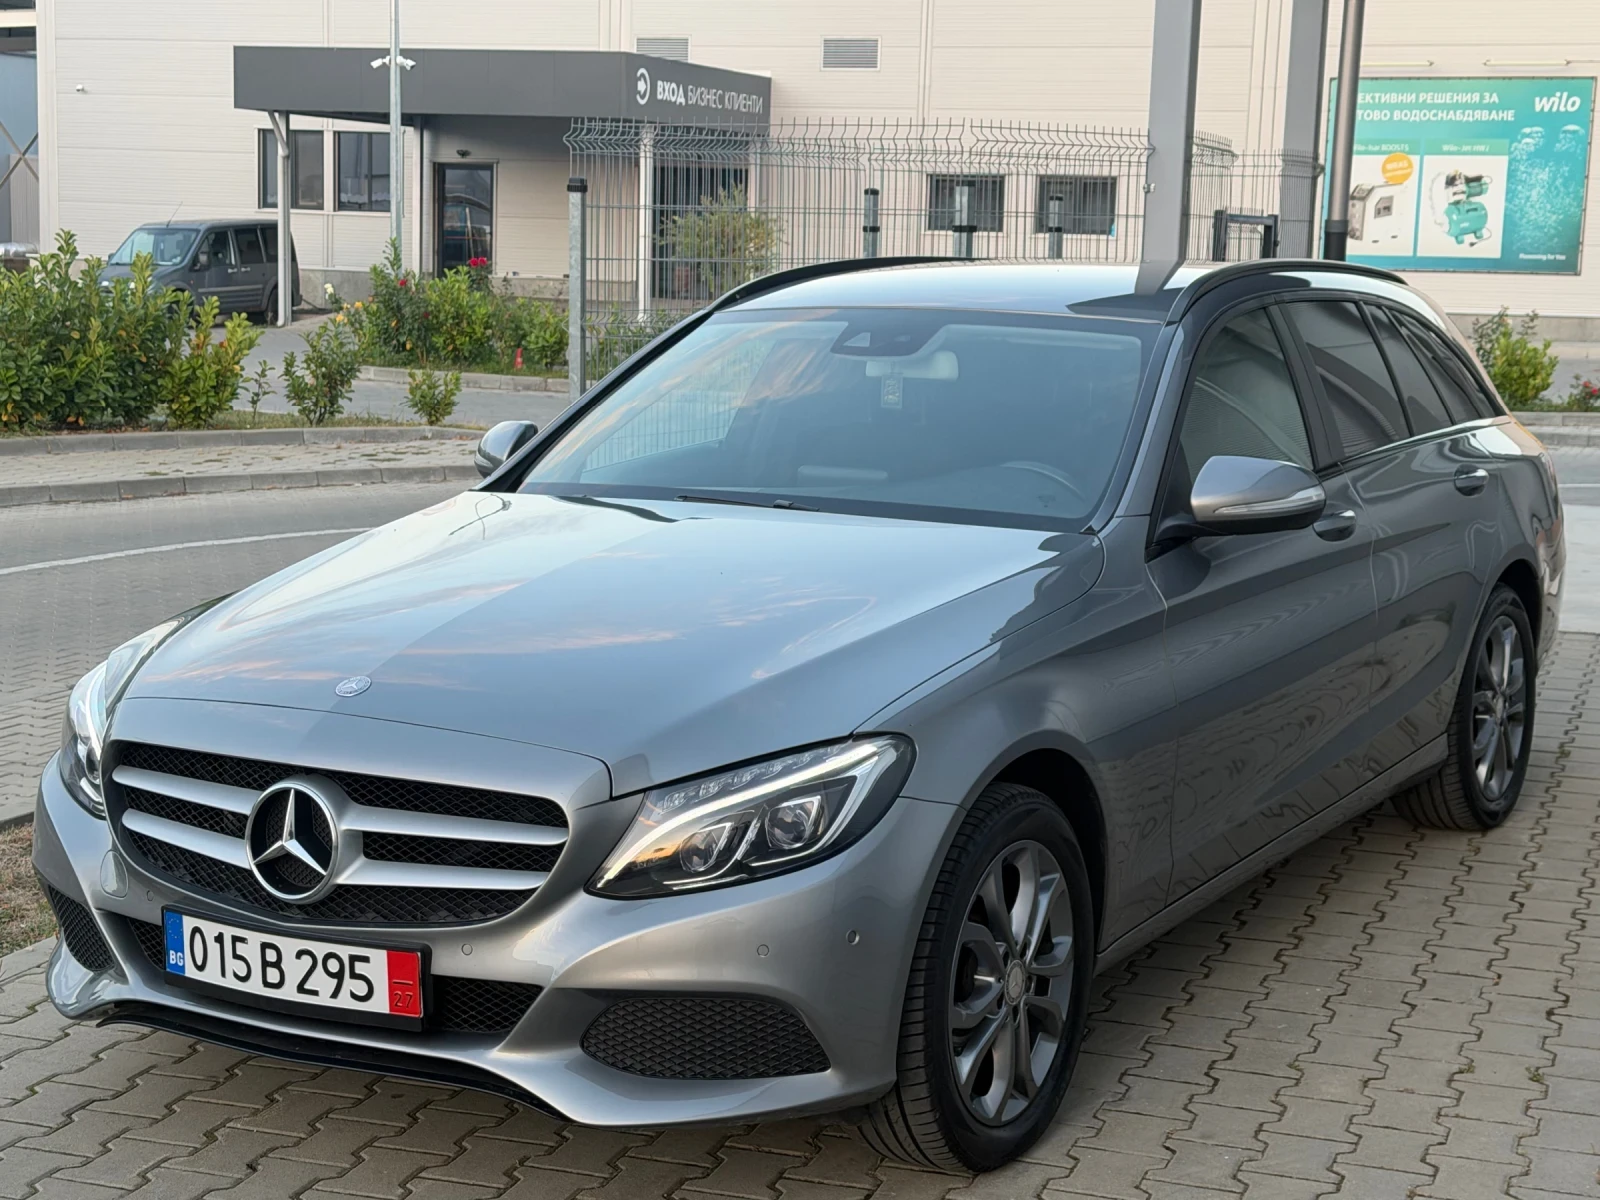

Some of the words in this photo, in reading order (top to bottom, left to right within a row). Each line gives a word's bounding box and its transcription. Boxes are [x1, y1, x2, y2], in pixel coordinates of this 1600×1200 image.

[656, 80, 686, 106] ВХОД
[687, 85, 723, 109] БИЗНЕС
[724, 91, 763, 114] КЛИЕНТИ
[1418, 92, 1480, 104] РЕШЕНИЯ
[1482, 92, 1499, 104] ЗА
[1534, 91, 1581, 112] wilo
[1393, 109, 1515, 122] ВОДОСНАБДЯВАНЕ
[169, 949, 184, 967] BG
[393, 991, 413, 1009] 27
